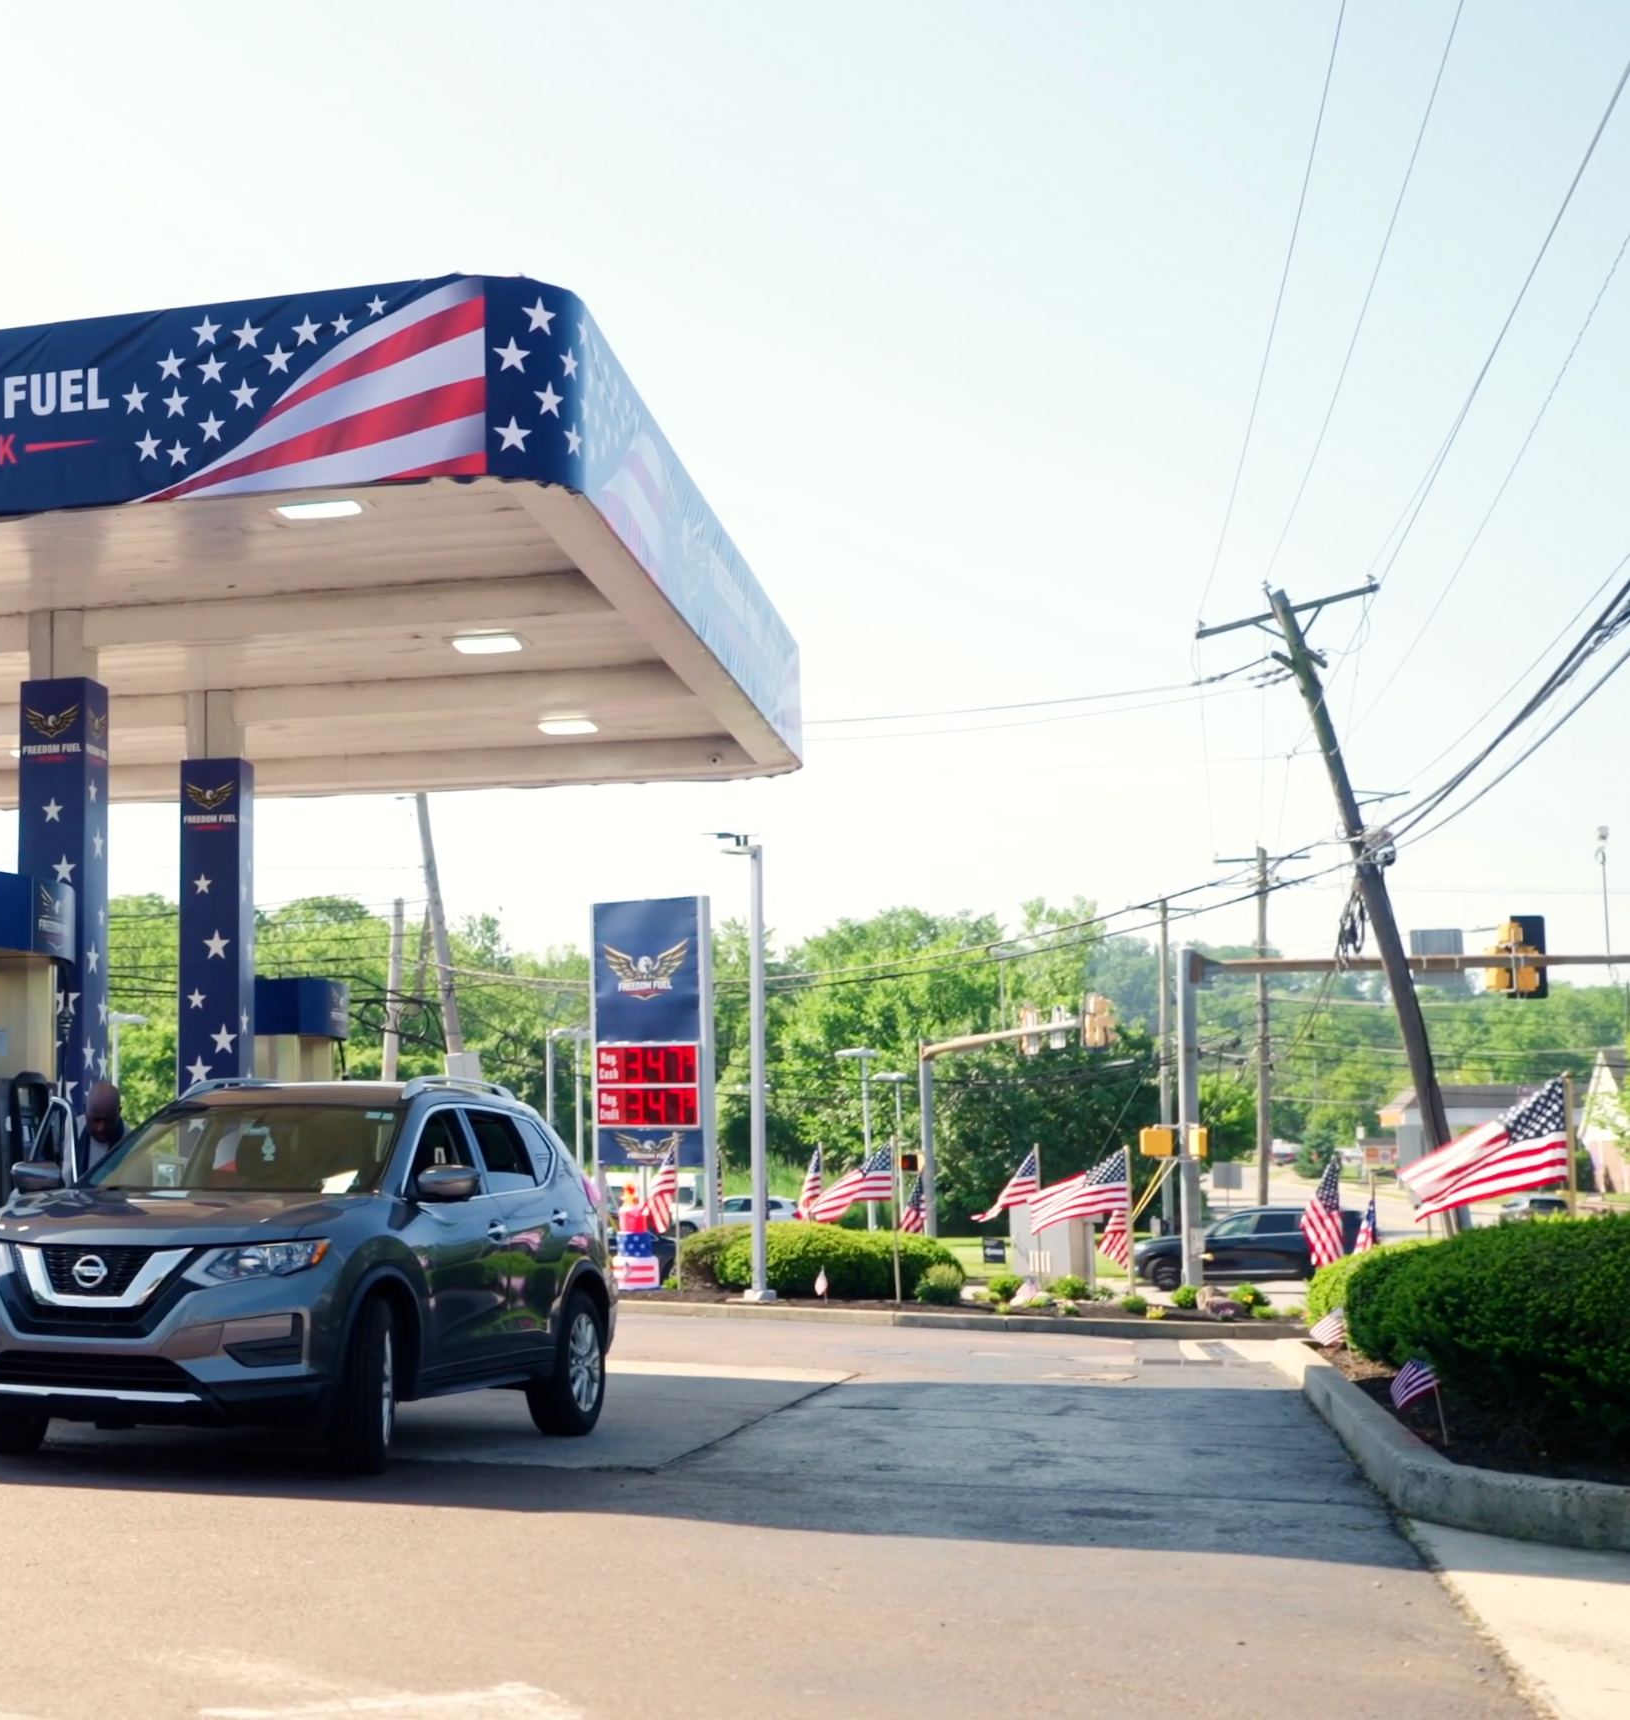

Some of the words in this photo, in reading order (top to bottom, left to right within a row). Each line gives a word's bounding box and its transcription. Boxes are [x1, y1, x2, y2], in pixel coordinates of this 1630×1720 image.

[4, 368, 109, 419] FUEL
[22, 743, 60, 755] FREEDOM
[62, 742, 81, 753] FUEL
[183, 814, 217, 824] FREEDOM
[218, 814, 236, 823] FUEL
[618, 980, 652, 992] FREEDOM
[653, 980, 673, 990] FUEL
